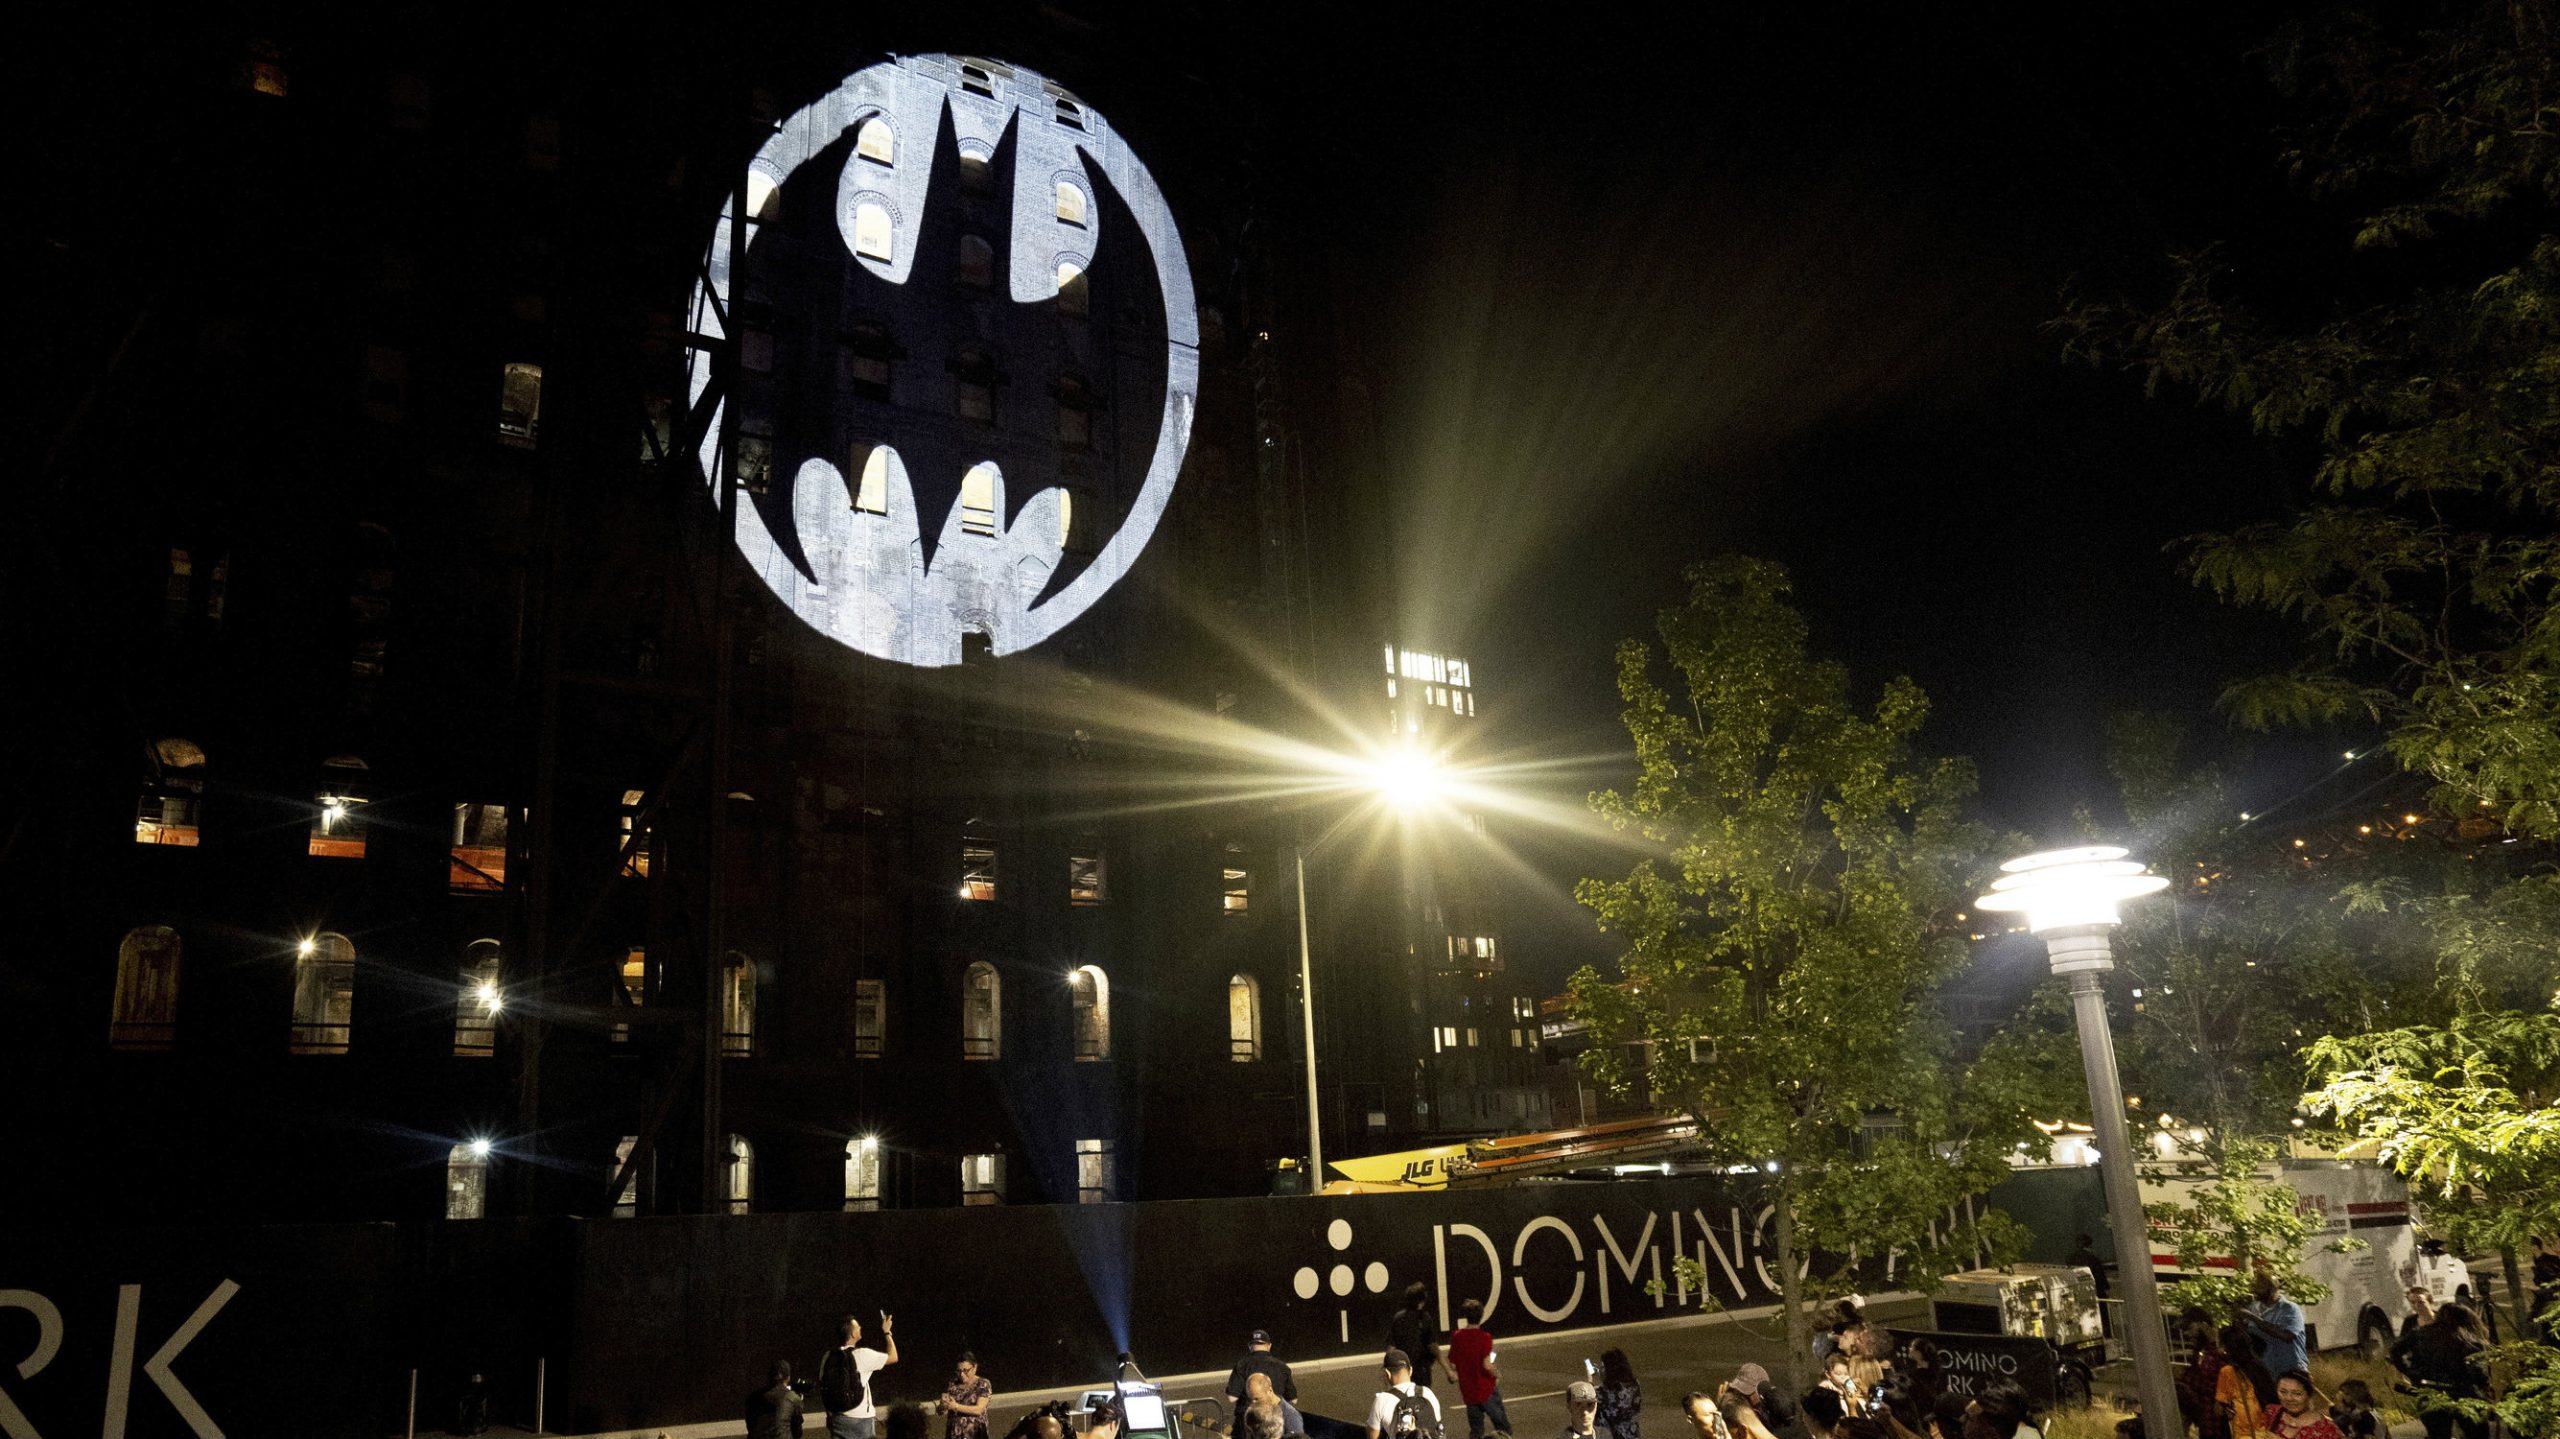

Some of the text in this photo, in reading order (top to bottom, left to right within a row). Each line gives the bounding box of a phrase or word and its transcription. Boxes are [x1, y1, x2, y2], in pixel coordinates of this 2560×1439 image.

[1401, 1159, 1434, 1181] JLG
[1937, 1349, 2018, 1375] OMINO
[1948, 1374, 1975, 1396] RK
